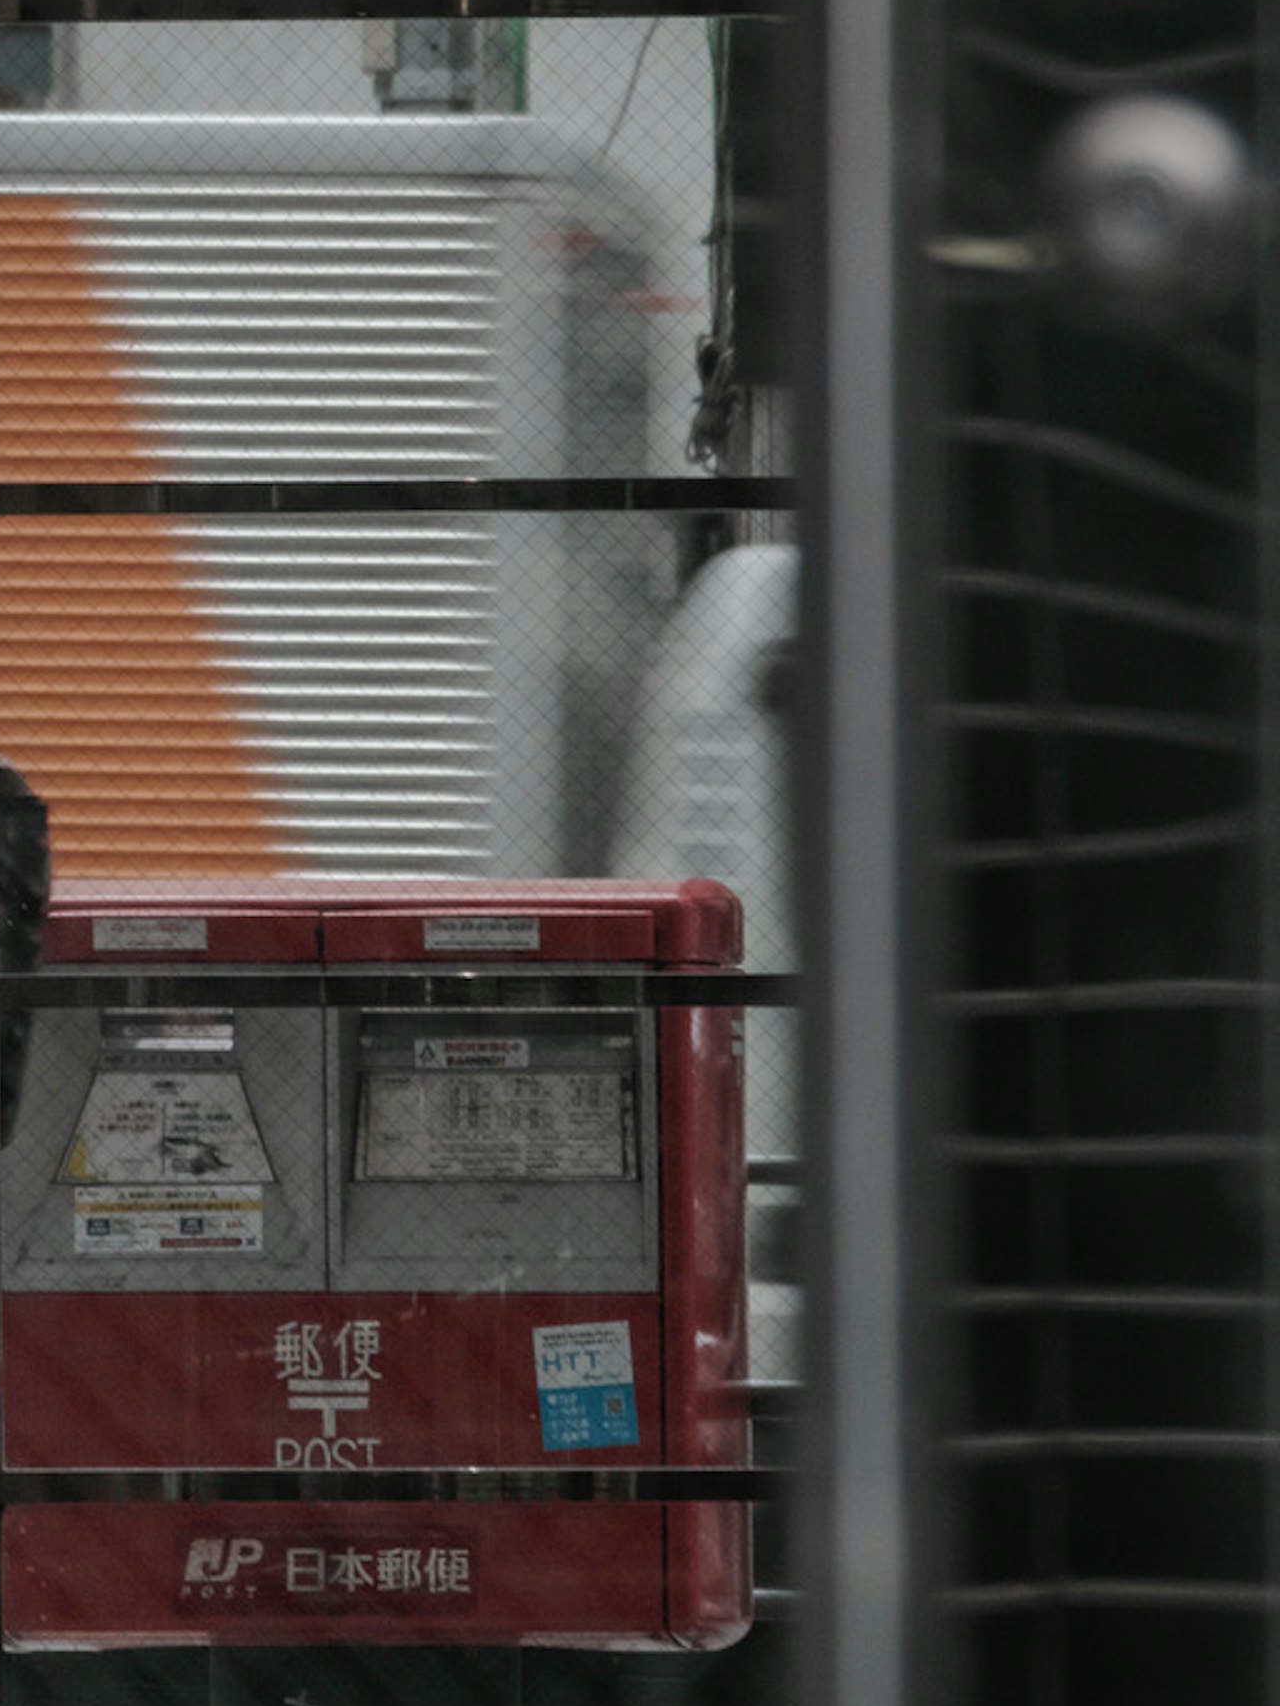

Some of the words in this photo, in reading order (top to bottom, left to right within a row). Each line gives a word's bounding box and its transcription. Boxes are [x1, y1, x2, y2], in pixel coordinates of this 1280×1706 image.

[275, 1321, 383, 1379] 郵便
[543, 1350, 600, 1372] HTT
[275, 1438, 381, 1469] POST
[286, 1547, 471, 1593] 日本郵便
